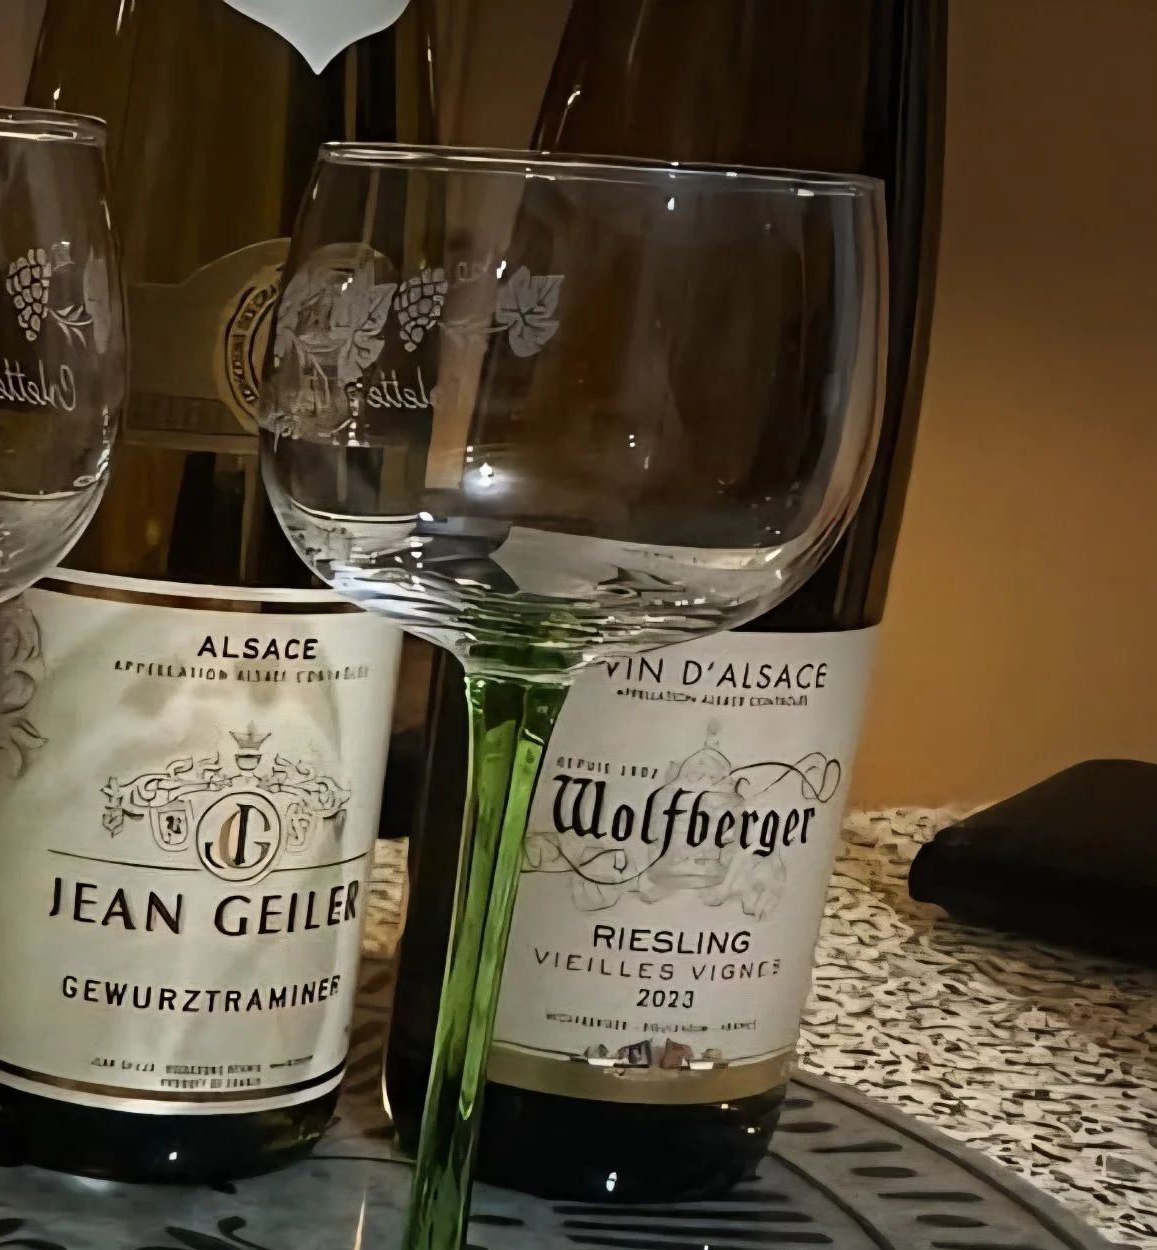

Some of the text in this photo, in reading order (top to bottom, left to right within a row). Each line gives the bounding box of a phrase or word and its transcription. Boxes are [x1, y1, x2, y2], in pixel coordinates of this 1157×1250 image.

[197, 635, 320, 661] ALSACE
[605, 656, 828, 689] VIN D'ALSACE
[552, 774, 816, 858] Wolfberger
[49, 877, 360, 937] JEAN GEILER
[593, 924, 752, 955] RIESLING
[534, 947, 674, 980] VIEILLES
[61, 973, 341, 1014] GEWURZTRAMINER
[636, 988, 695, 1009] 2023
